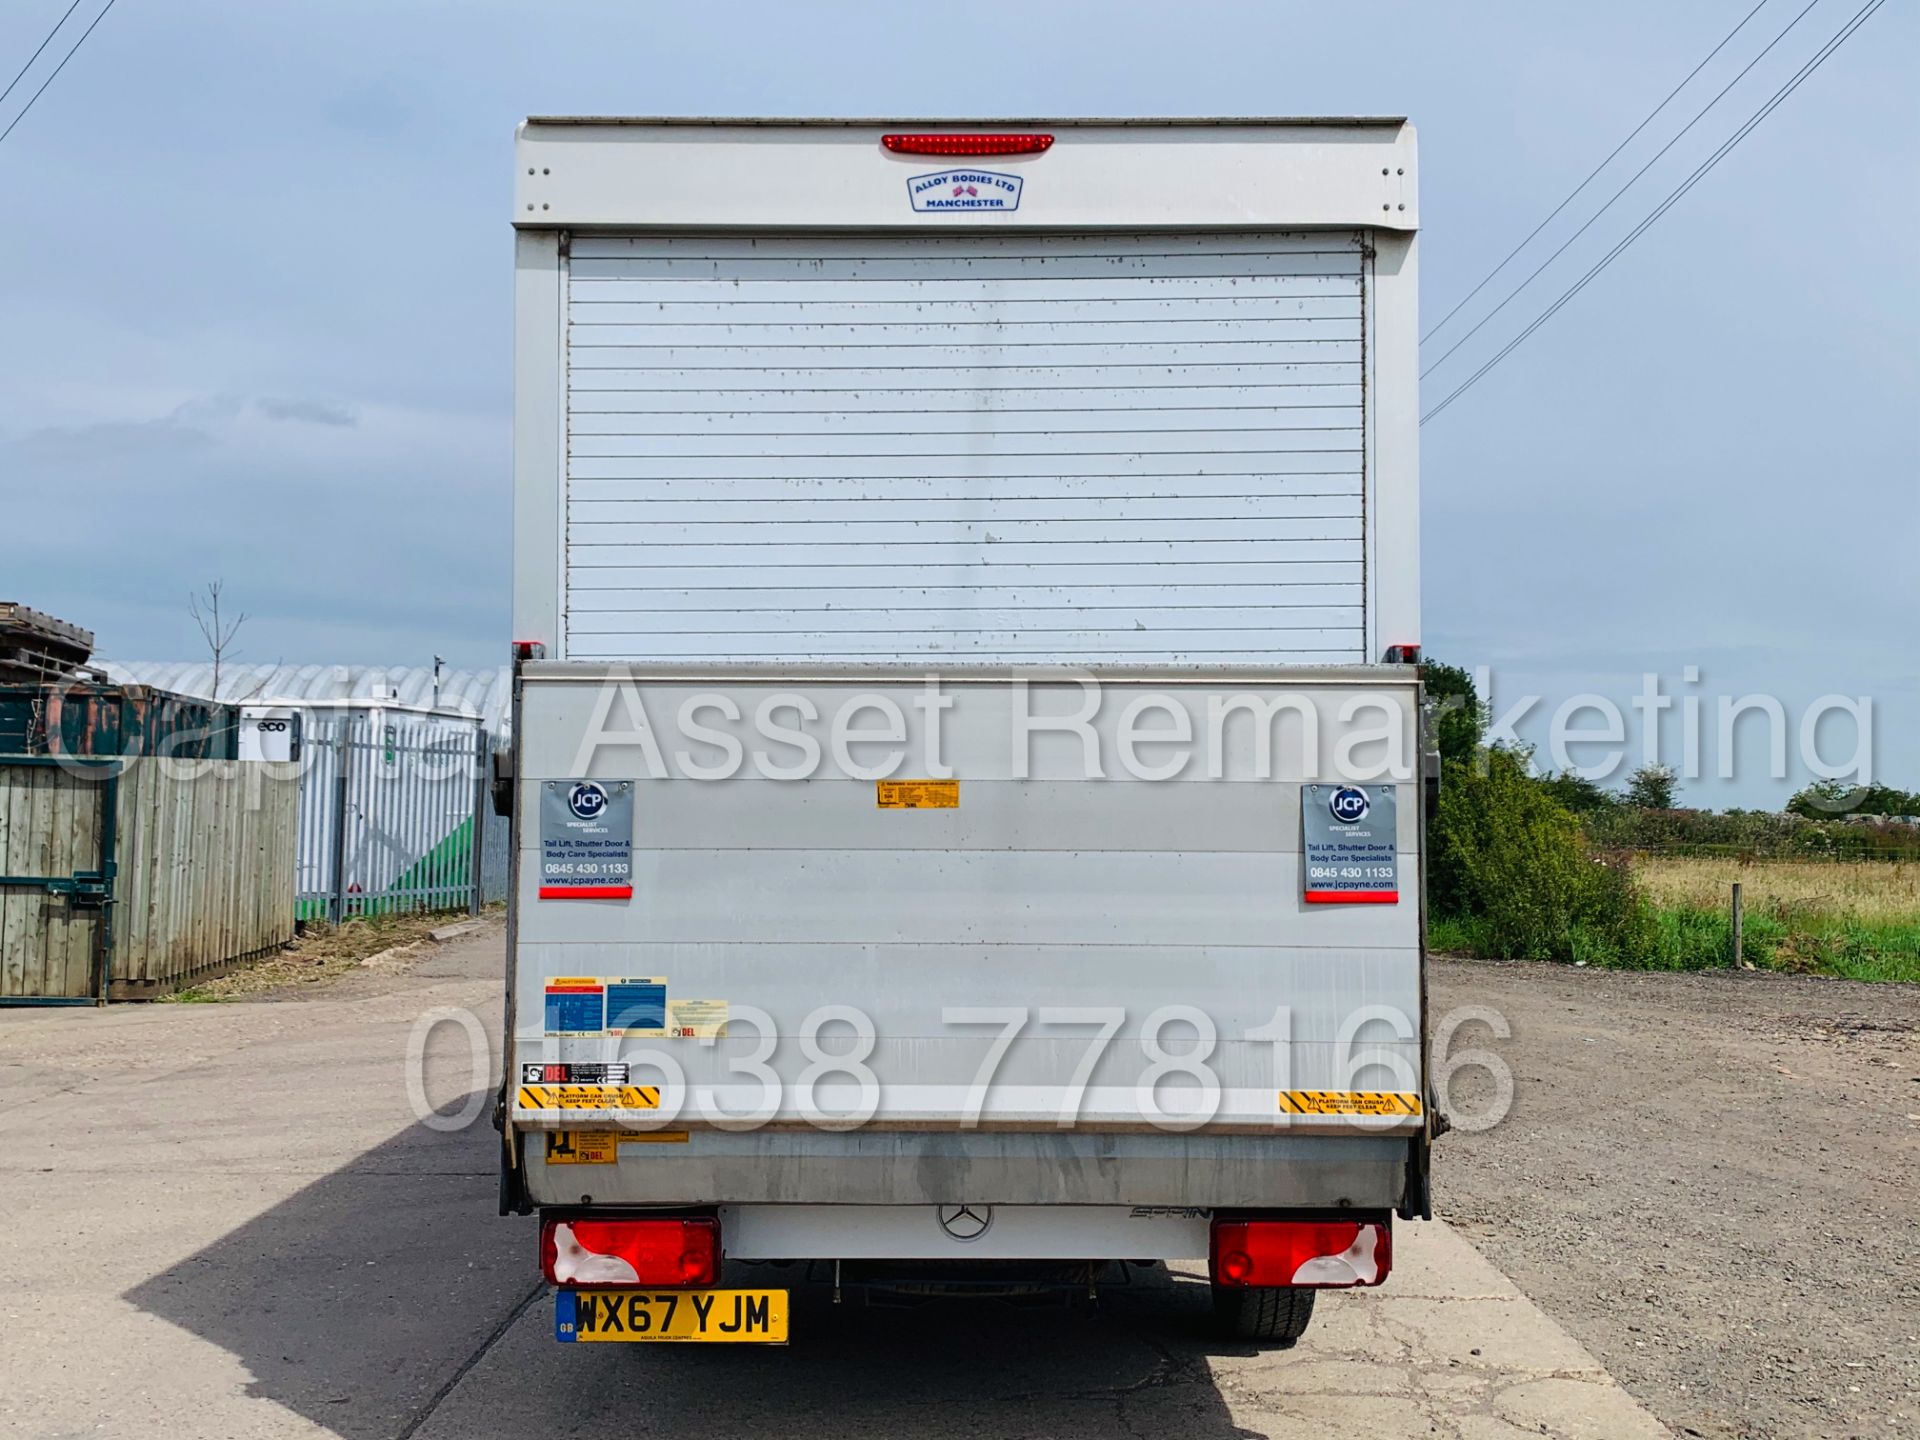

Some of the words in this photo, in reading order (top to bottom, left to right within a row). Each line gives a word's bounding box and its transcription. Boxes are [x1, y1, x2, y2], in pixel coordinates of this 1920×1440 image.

[915, 176, 948, 194] ALLOY
[952, 174, 992, 184] BODIES
[995, 178, 1015, 192] LTD
[926, 199, 1004, 208] MANCHESTER
[258, 721, 286, 732] eco
[574, 793, 602, 807] JCP
[1336, 797, 1364, 811] JCP
[546, 850, 565, 859] Body
[567, 850, 586, 858] Care
[587, 850, 628, 858] Specialists
[1310, 854, 1329, 863] Body
[1330, 854, 1349, 862] Care
[1350, 854, 1392, 863] Specialists
[545, 863, 574, 874] 0845
[576, 863, 598, 874] 430
[601, 863, 629, 874] 1133
[1310, 867, 1338, 878] 0845
[1340, 867, 1362, 878] 430
[1365, 867, 1393, 878] 1133
[1310, 880, 1394, 890] www.jcpayne.com
[682, 1028, 695, 1037] DEL
[545, 1065, 568, 1082] DEL
[590, 1151, 603, 1160] DEL
[577, 1295, 679, 1333] WX67
[691, 1295, 769, 1333] YJM
[560, 1323, 574, 1333] GB
